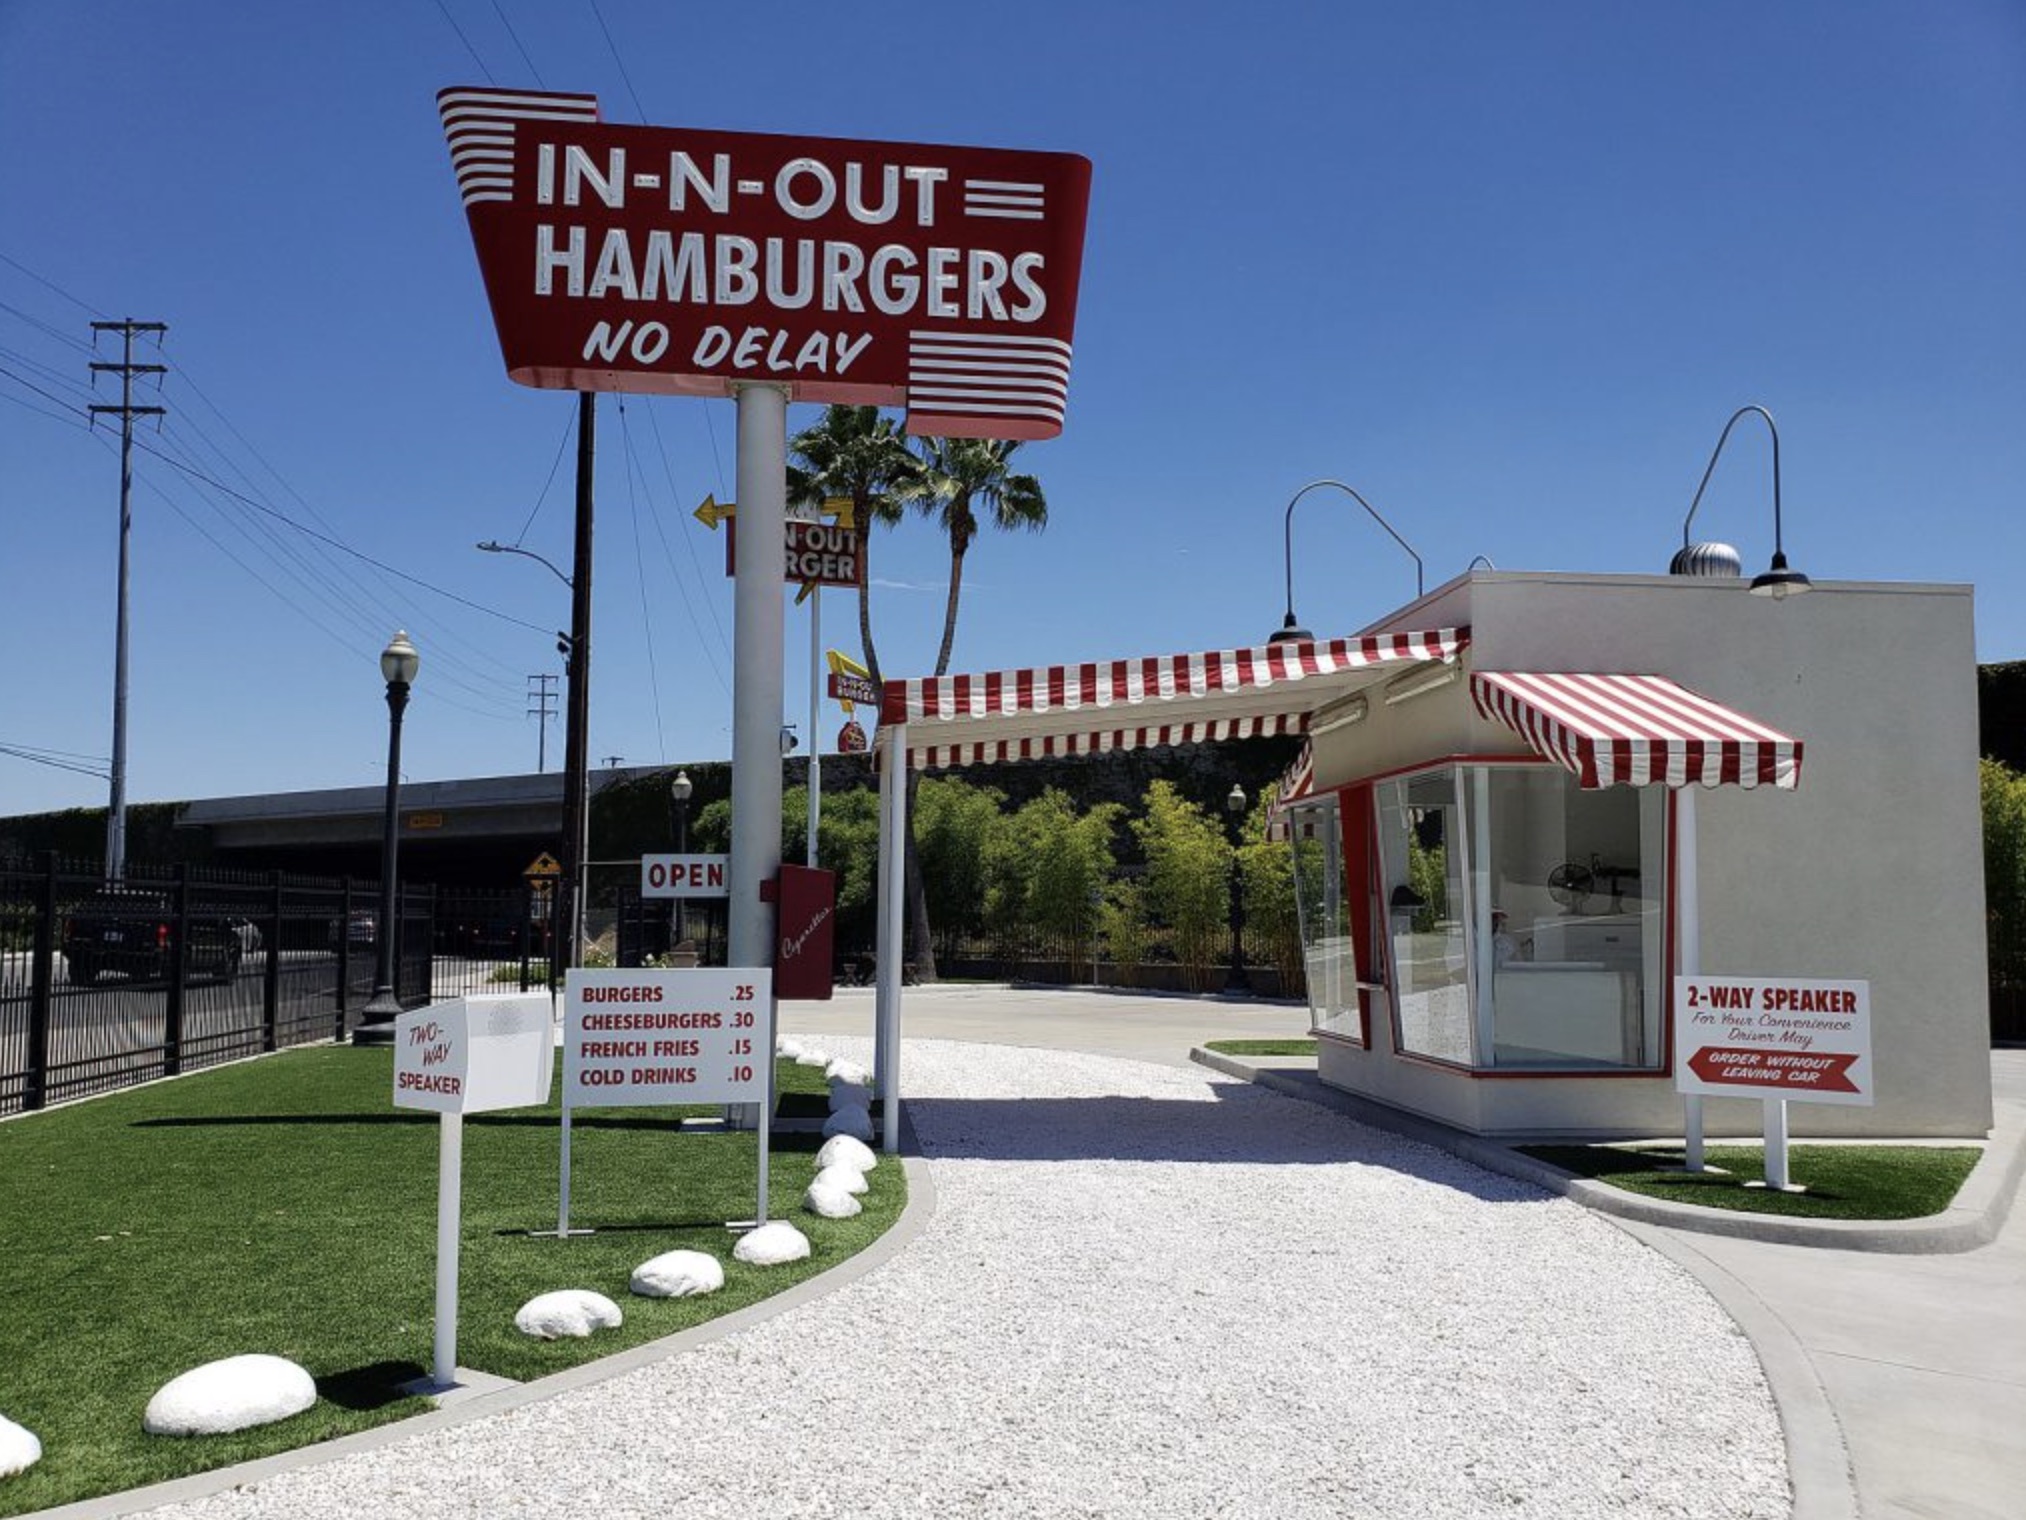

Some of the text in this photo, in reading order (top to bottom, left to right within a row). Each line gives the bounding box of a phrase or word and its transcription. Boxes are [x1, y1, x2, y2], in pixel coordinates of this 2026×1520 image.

[537, 143, 948, 227] IN-N-OUT
[535, 224, 1047, 323] HAMBURGERS
[582, 320, 873, 374] NO DELAY
[649, 863, 723, 888] OPEN
[582, 985, 754, 1002] BURGERS .25
[1688, 985, 1857, 1014] 2-WAY SPEAKER
[581, 1012, 754, 1031] CHEESEBURGERS .30
[1691, 1011, 1851, 1030] For Your Convenience
[581, 1039, 752, 1058] FRENCH FRIES .15
[1728, 1028, 1813, 1050] Driver May
[423, 1040, 453, 1067] WAY
[1709, 1051, 1836, 1070] ORDER WITHOUT
[399, 1072, 461, 1095] SPEAKER
[580, 1066, 753, 1086] COLD DRINKS .10
[1721, 1066, 1821, 1083] LEAVING CAR
